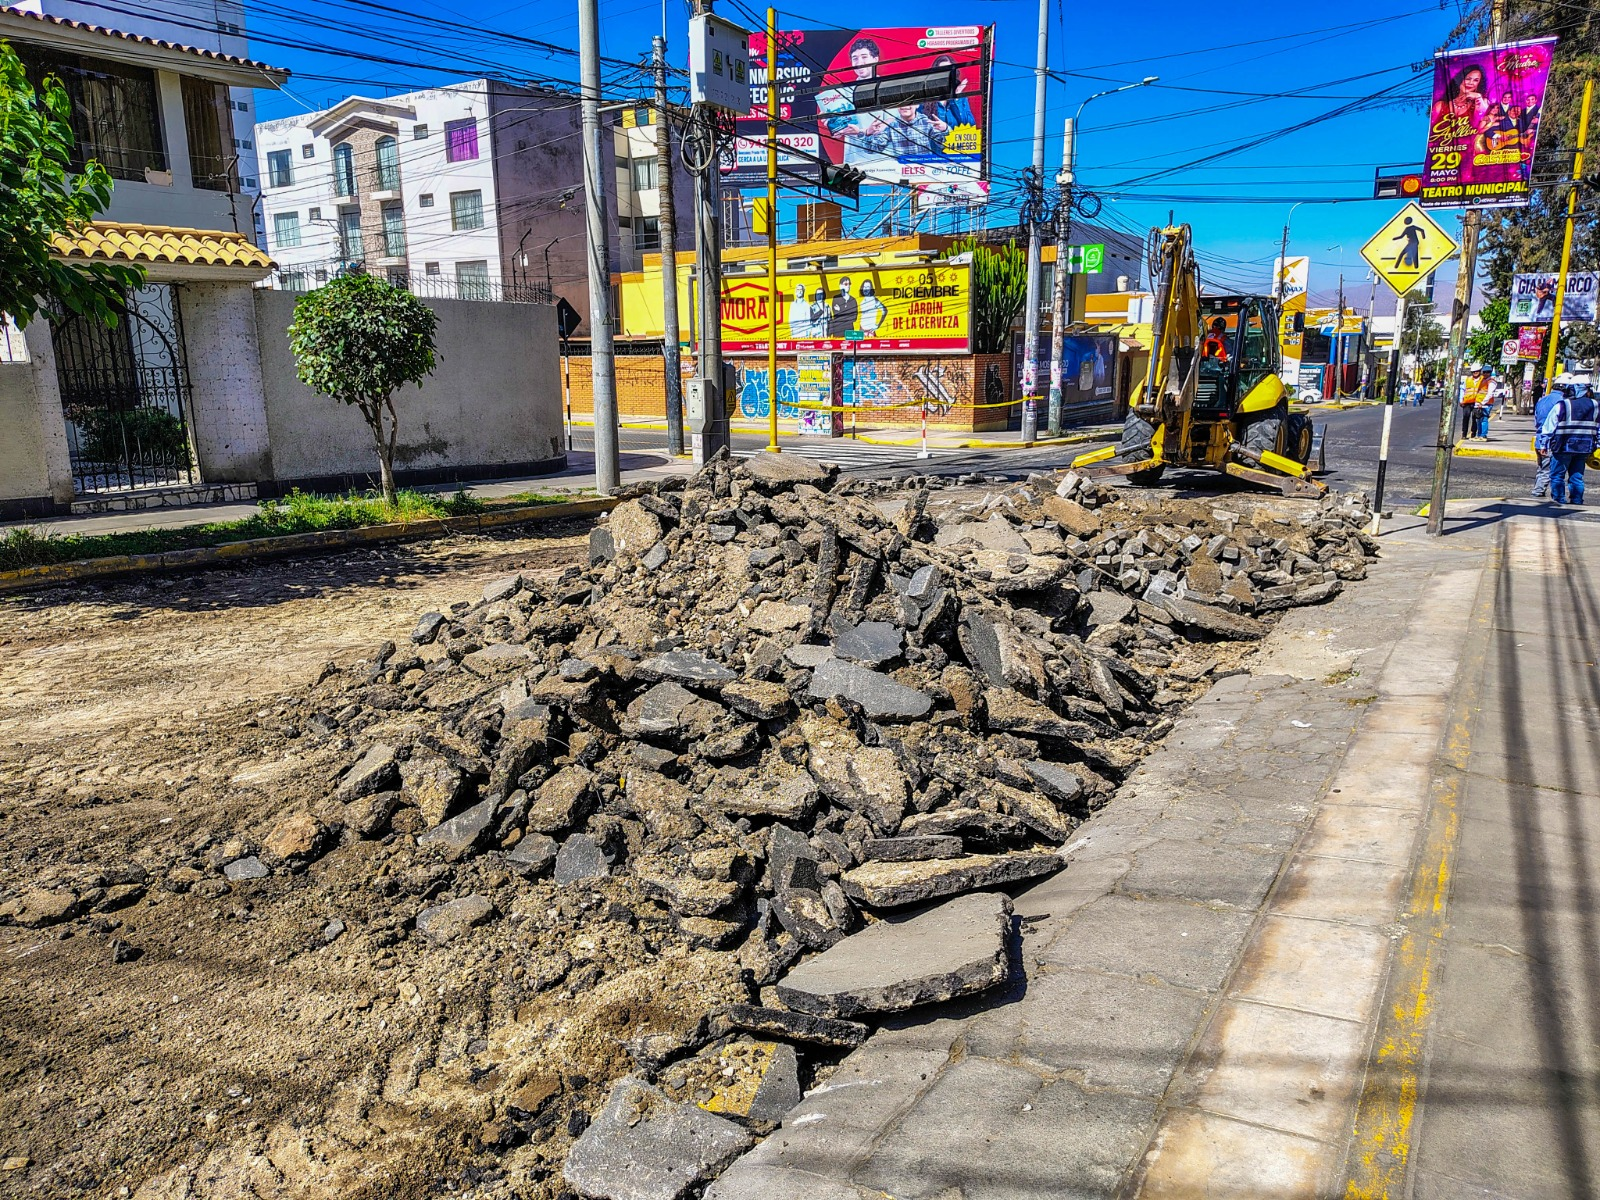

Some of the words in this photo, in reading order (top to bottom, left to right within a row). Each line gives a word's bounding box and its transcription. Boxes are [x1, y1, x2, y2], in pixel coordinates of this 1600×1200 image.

[794, 137, 813, 147] 320
[957, 142, 977, 150] MESES
[1430, 144, 1468, 153] VIERNES
[1431, 152, 1462, 170] 29
[901, 166, 926, 175] IELTS
[1422, 186, 1462, 198] TEATRO
[1465, 181, 1528, 196] MUNICIPAL
[919, 273, 934, 285] 05
[892, 285, 960, 299] DICIEMBRE
[908, 300, 943, 315] JARDÍN
[893, 316, 904, 330] DE
[905, 316, 917, 329] LA
[919, 315, 959, 329] CERVEZA
